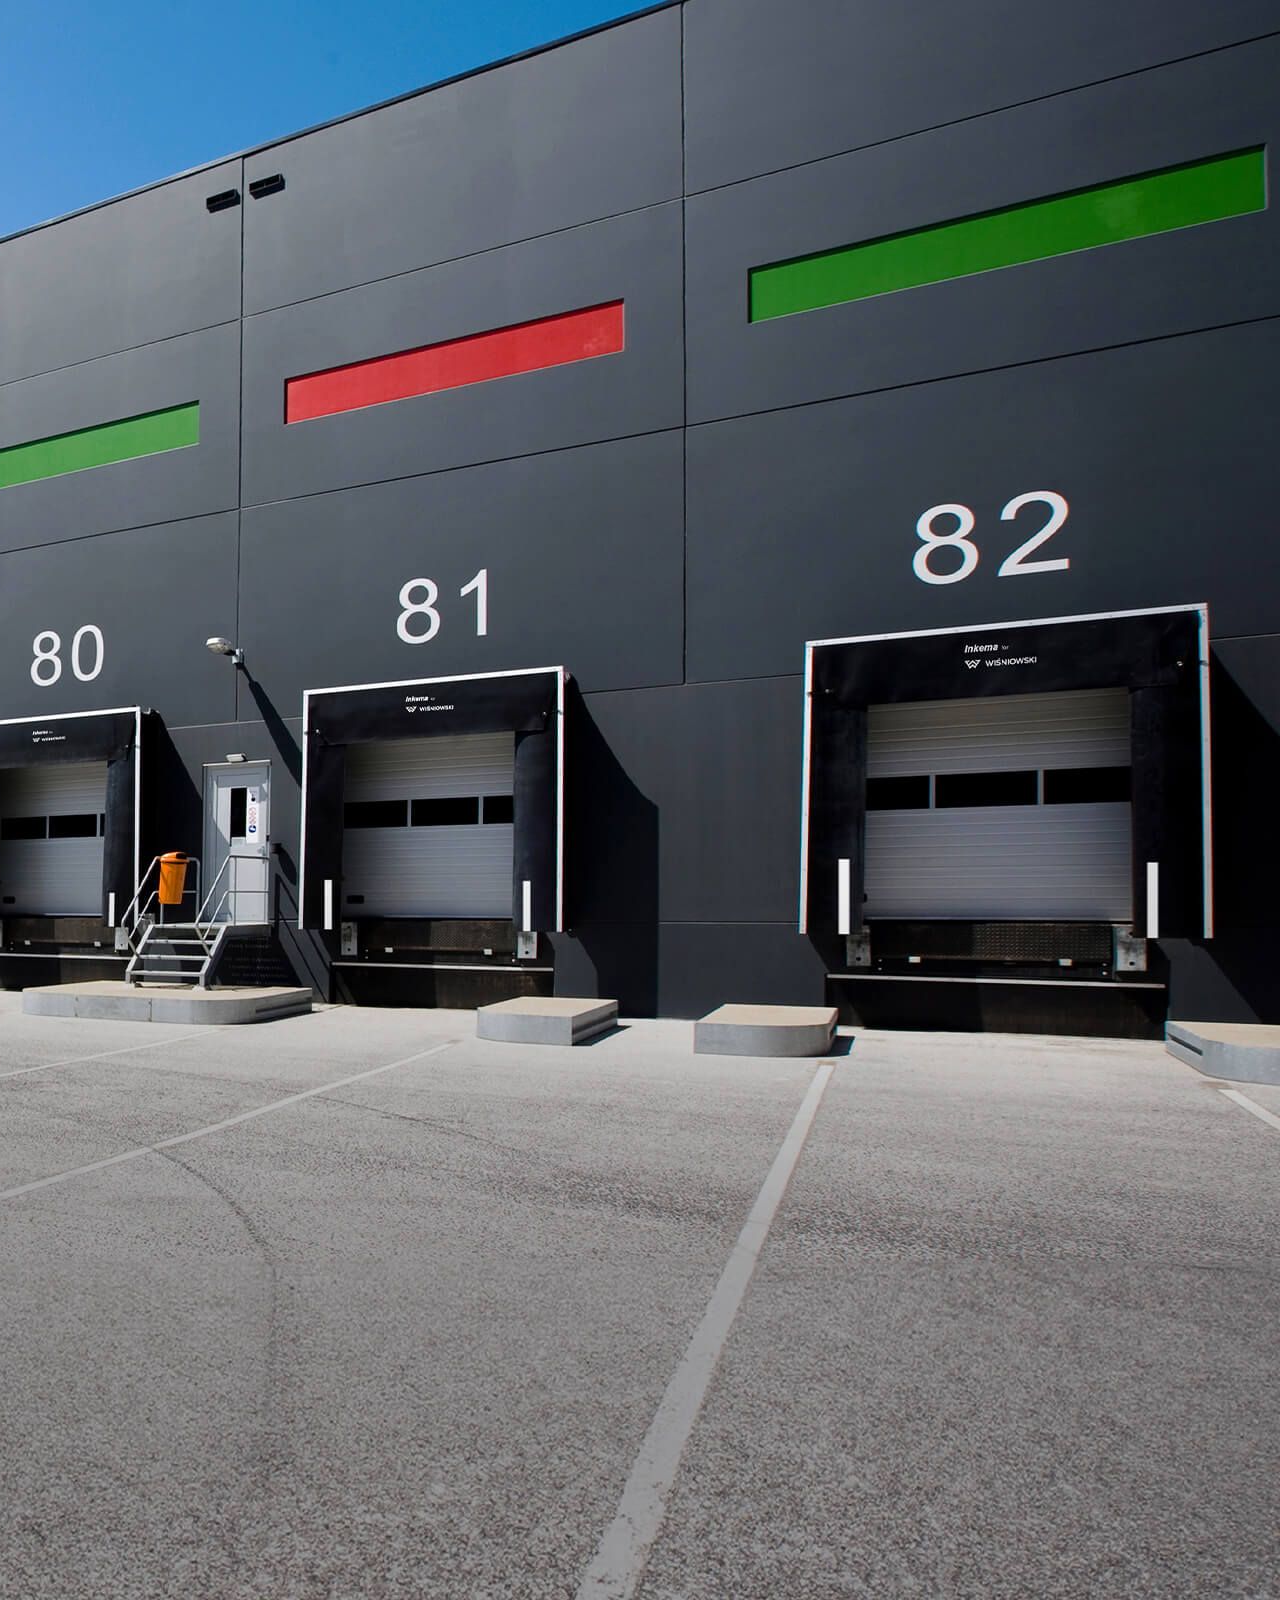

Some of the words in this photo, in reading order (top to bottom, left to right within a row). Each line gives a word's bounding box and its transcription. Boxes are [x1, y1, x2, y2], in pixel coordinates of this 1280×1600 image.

[912, 490, 1069, 585] 82
[396, 568, 488, 645] 81
[30, 624, 105, 688] 80
[964, 643, 999, 654] Inkema
[985, 656, 1038, 668] WIŚNIOWSKI
